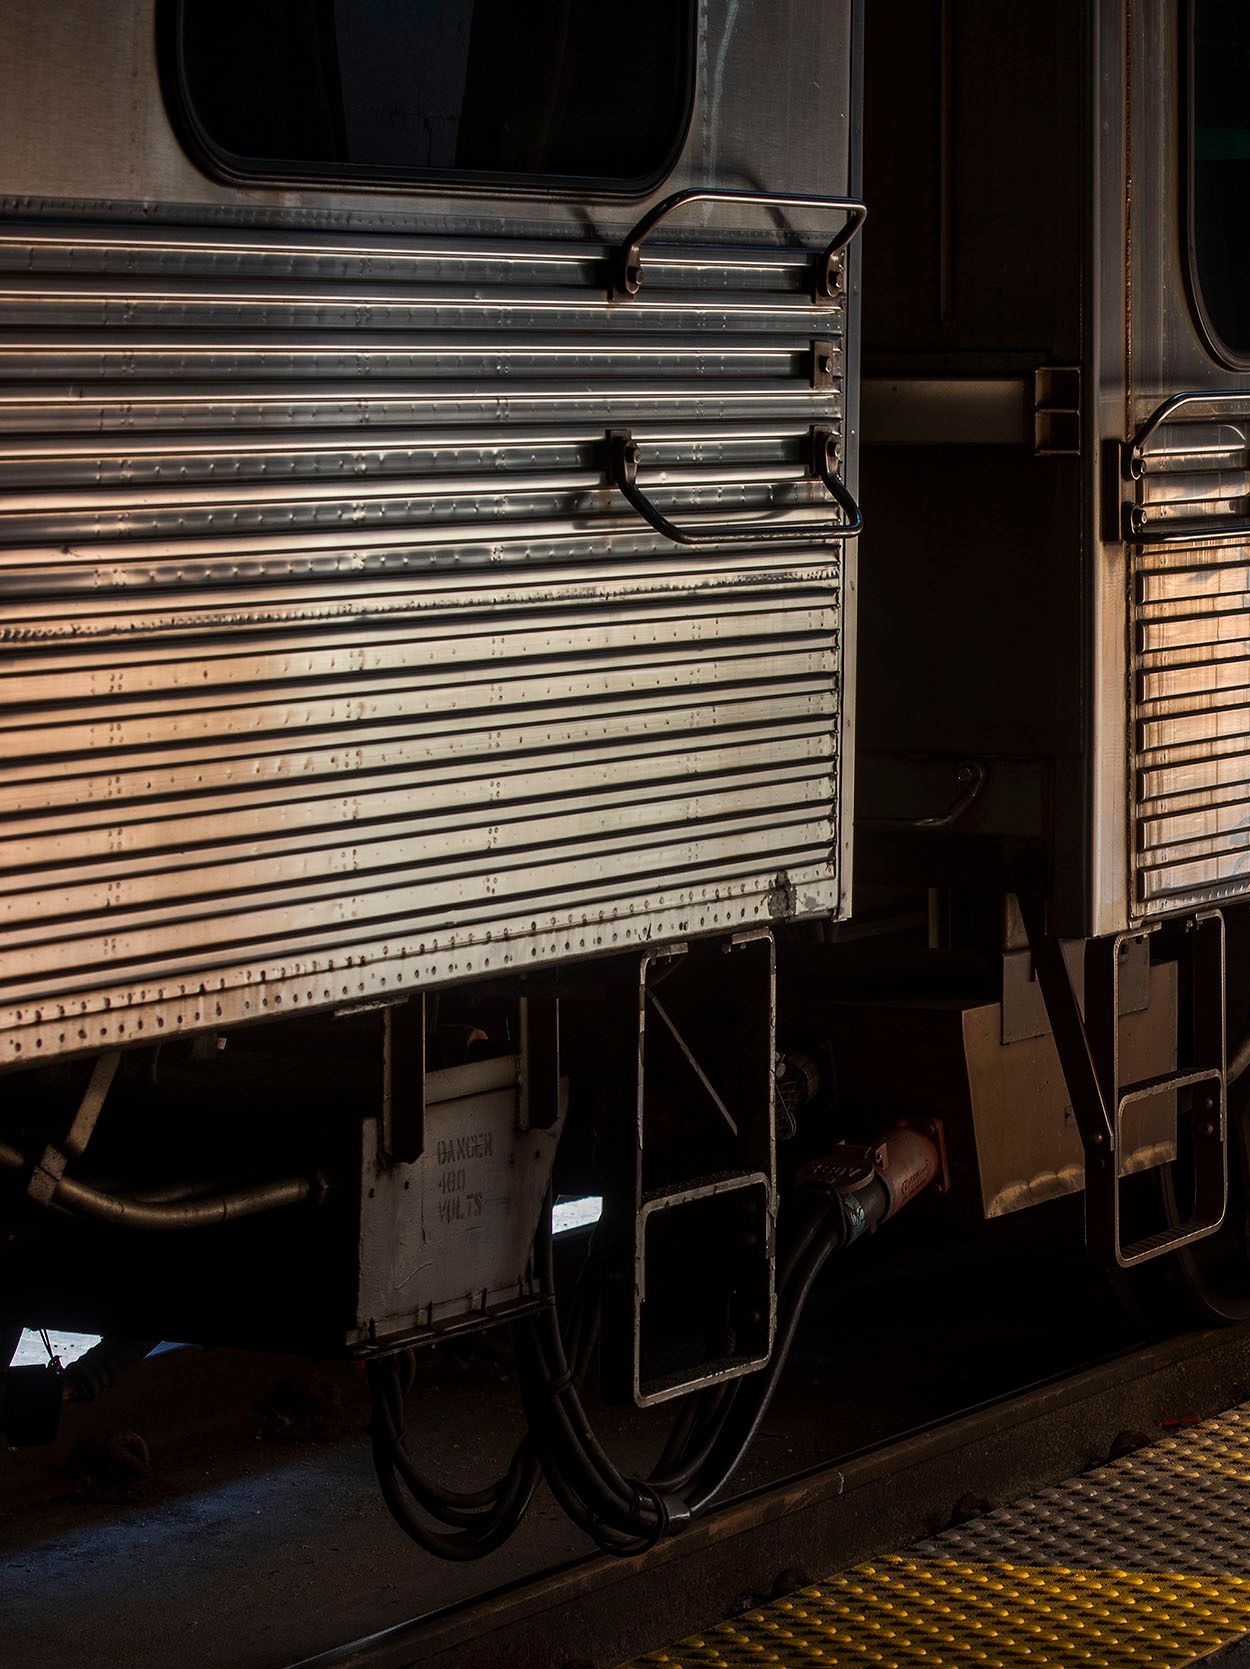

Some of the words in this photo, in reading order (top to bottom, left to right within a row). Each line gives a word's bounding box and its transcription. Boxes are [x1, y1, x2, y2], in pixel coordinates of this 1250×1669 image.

[437, 1132, 493, 1165] DANGER
[438, 1167, 466, 1194] 480
[438, 1191, 482, 1224] VOLTS
